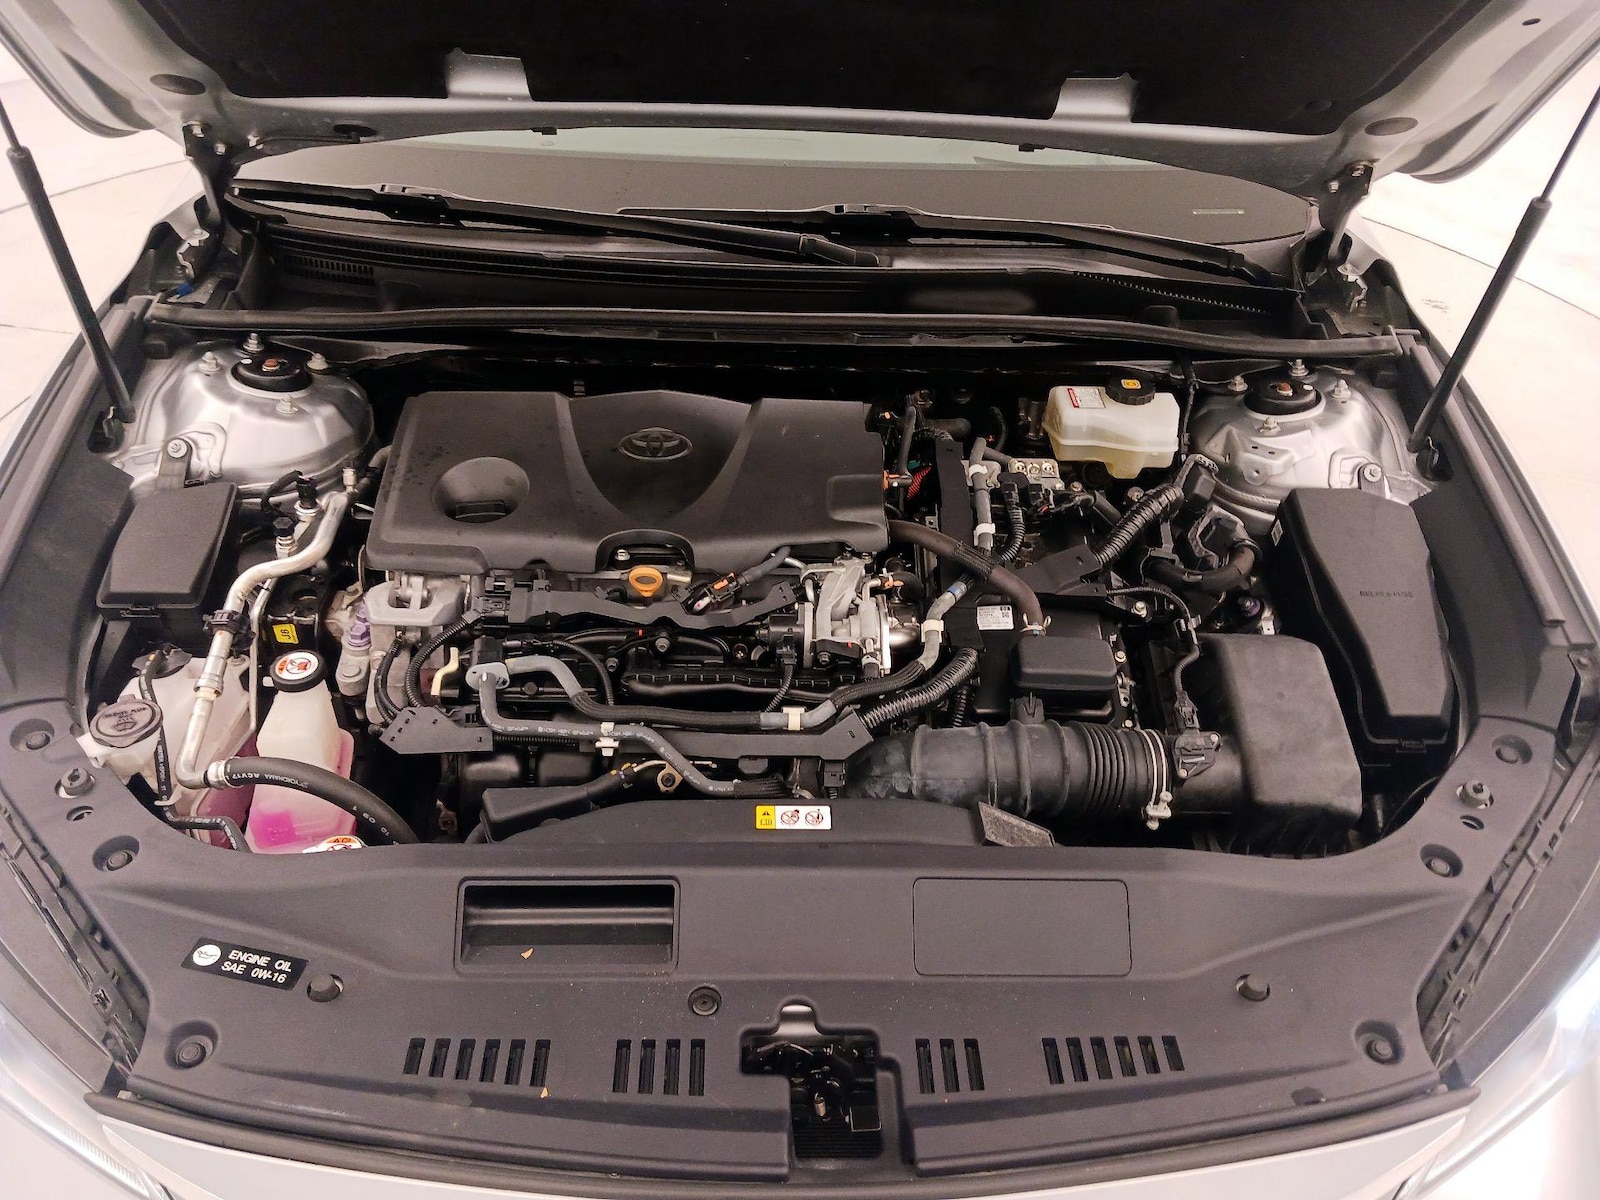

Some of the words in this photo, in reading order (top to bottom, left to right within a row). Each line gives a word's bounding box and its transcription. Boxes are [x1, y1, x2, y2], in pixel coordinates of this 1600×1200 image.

[232, 772, 260, 780] ACV17
[264, 774, 299, 786] YOKOHAMA
[228, 949, 271, 967] ENGINE
[274, 960, 292, 973] OIL
[221, 961, 247, 975] SAE
[250, 968, 287, 984] 0W-16
